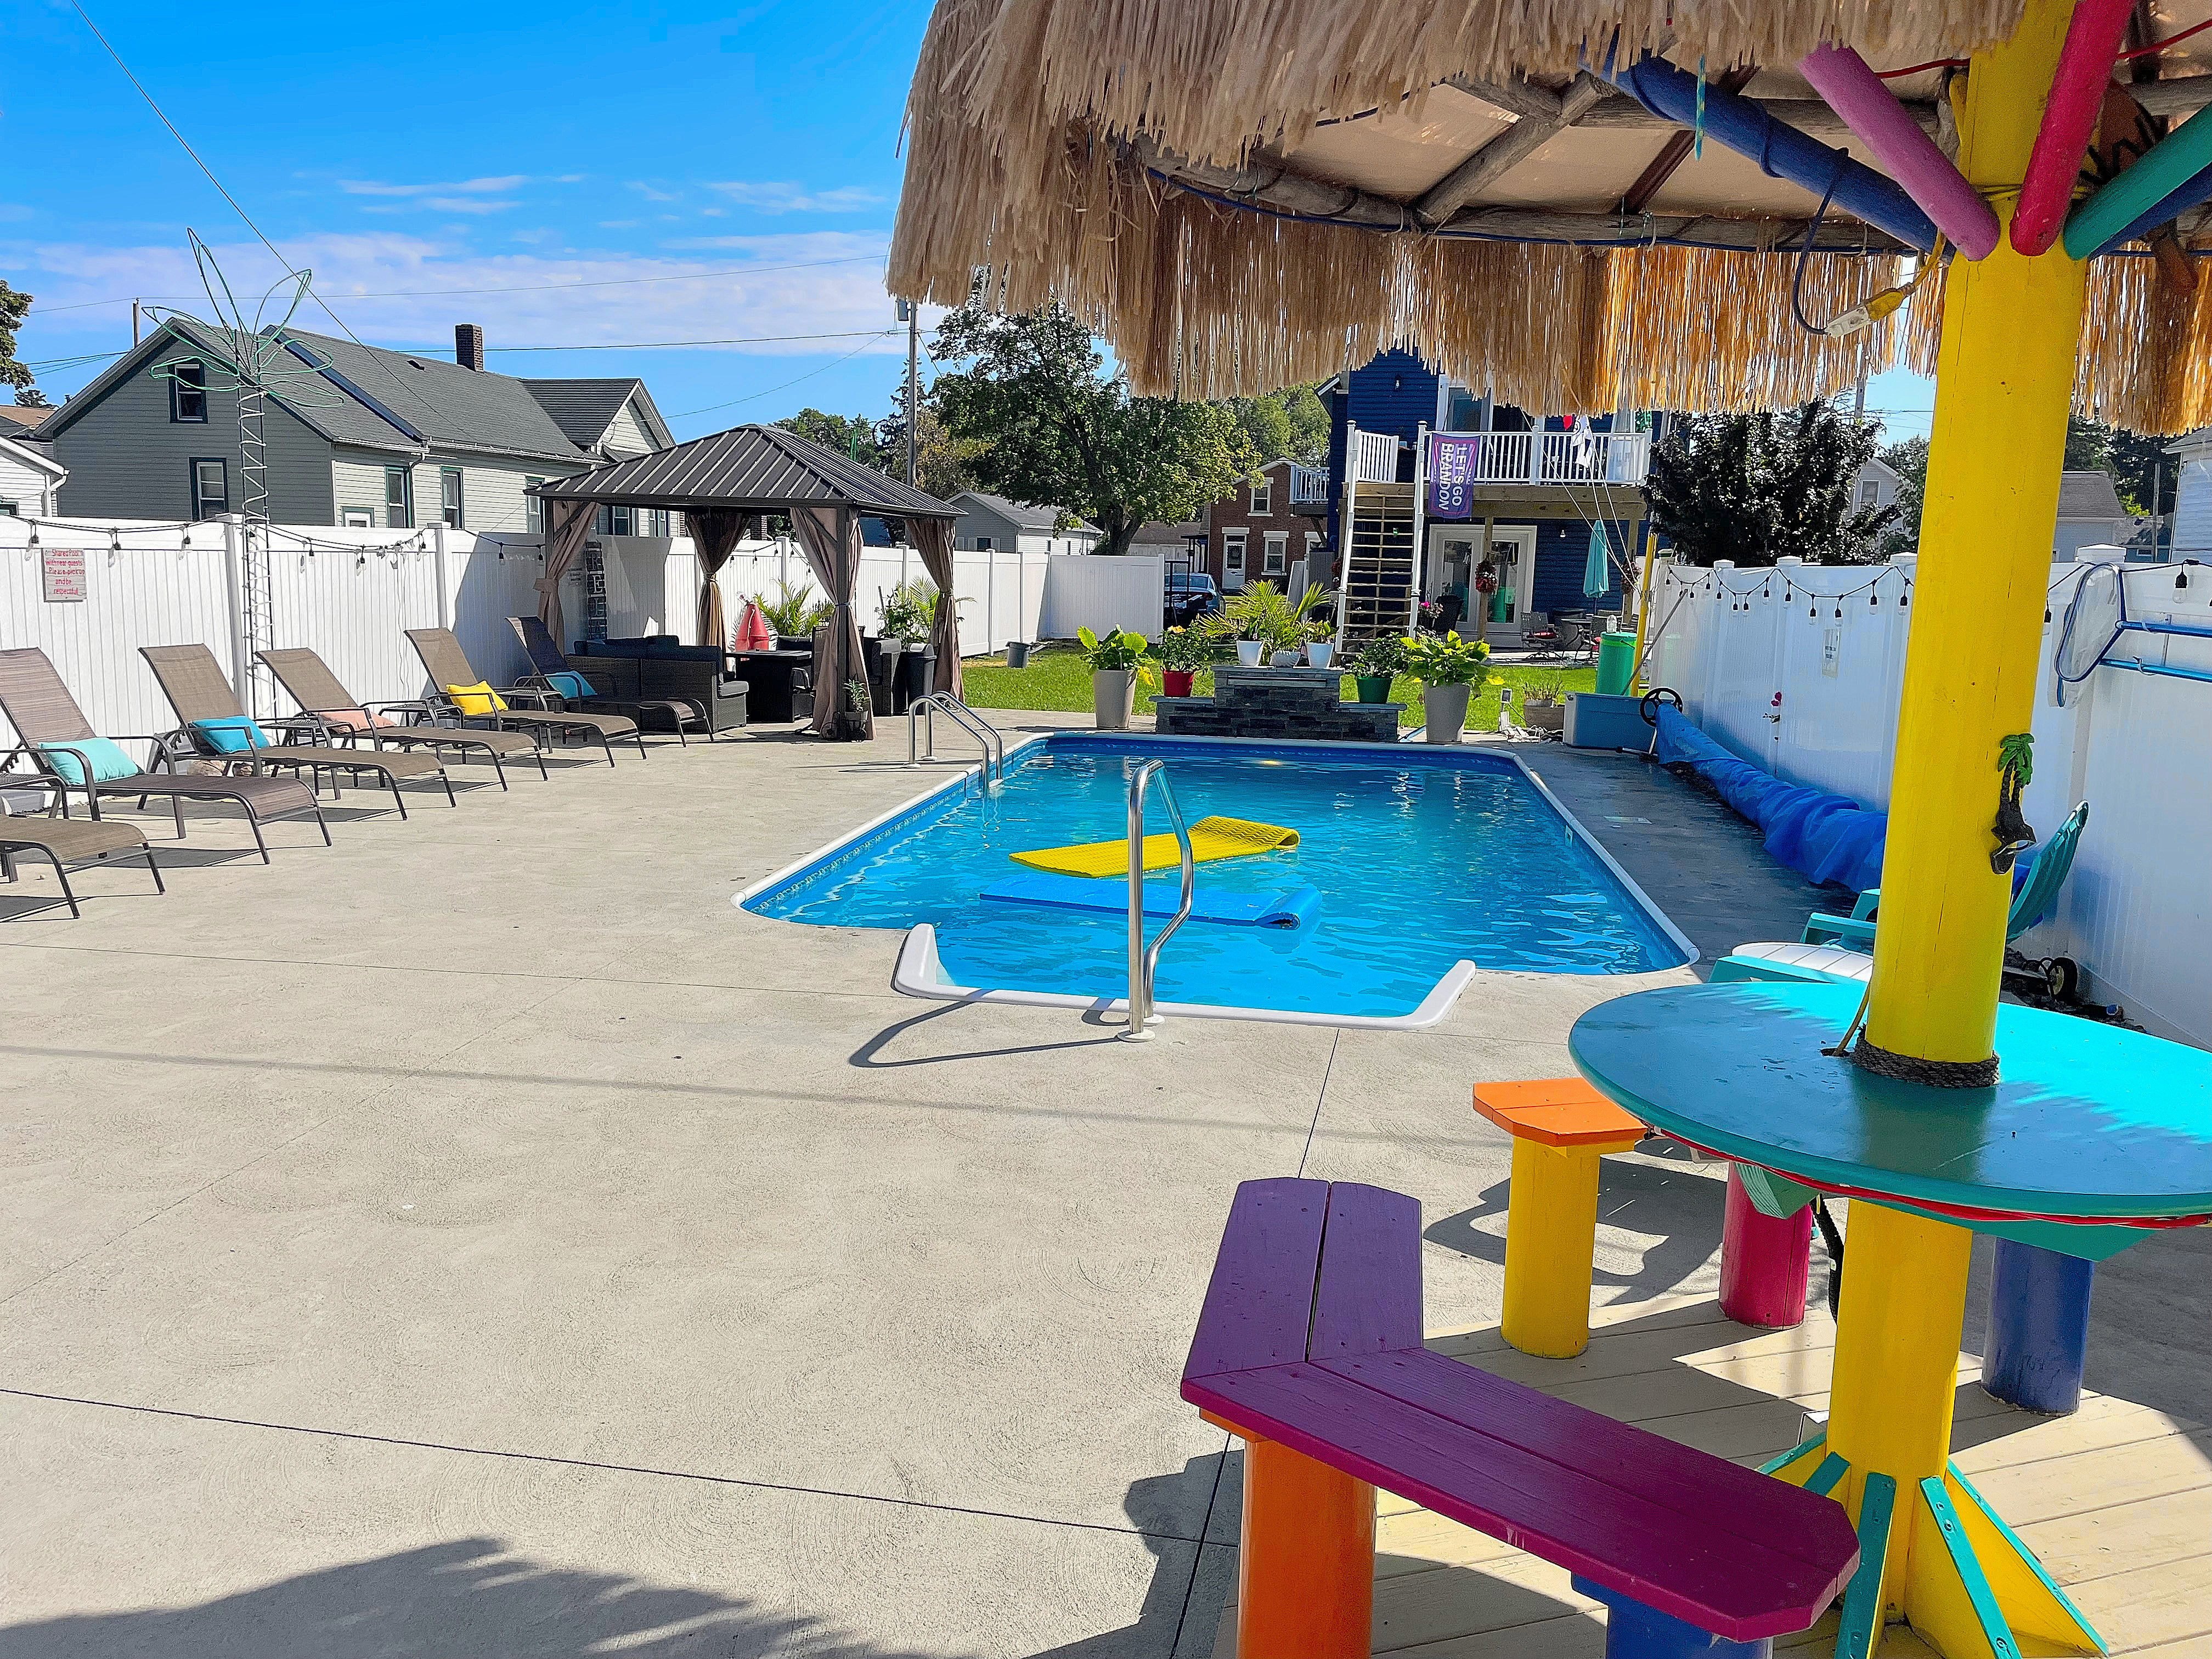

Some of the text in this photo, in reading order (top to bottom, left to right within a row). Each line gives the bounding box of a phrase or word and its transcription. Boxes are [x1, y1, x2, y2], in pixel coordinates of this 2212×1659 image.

[1438, 442, 1455, 511] BRANDON
[1452, 447, 1468, 506] LET'S GO
